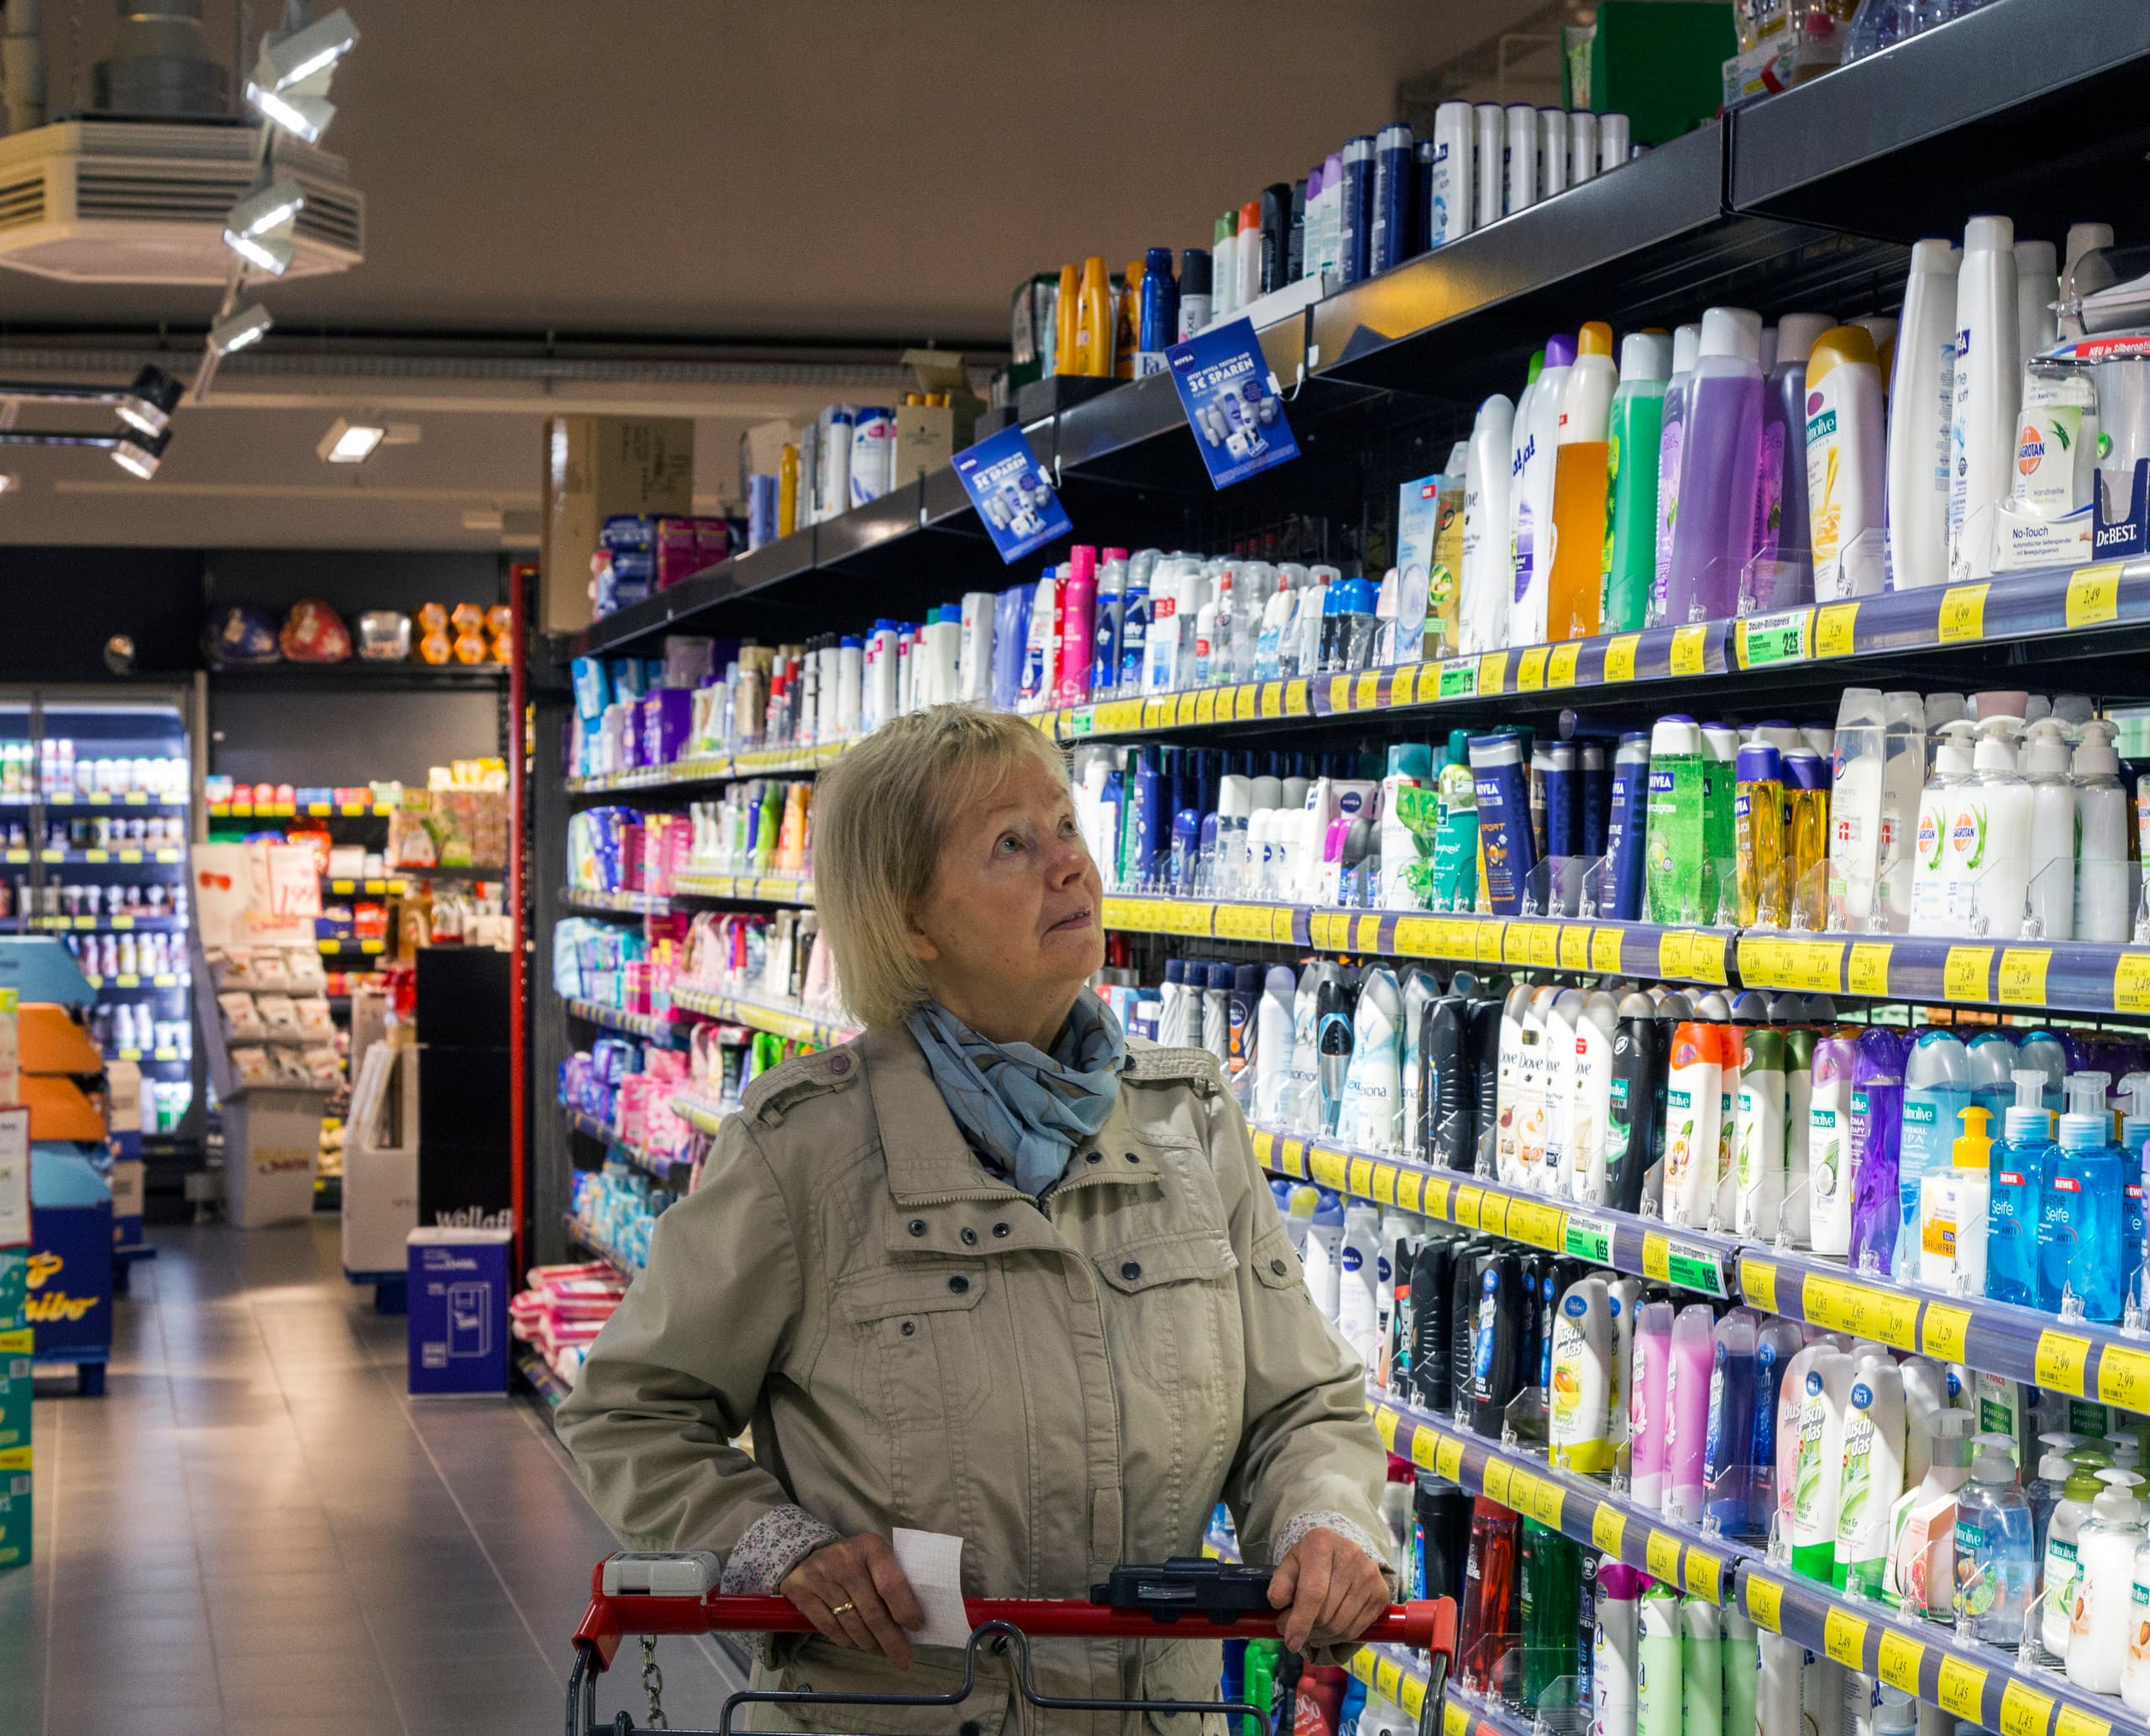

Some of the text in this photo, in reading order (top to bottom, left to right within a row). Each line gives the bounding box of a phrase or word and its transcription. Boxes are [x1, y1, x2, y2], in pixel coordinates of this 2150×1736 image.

[2089, 347, 2104, 356] NEU
[1173, 354, 1194, 366] NIVEA
[1188, 358, 1255, 392] 3€ SPAREN
[989, 456, 1027, 482] SPAREN
[2012, 526, 2048, 539] No-Touch
[1476, 781, 1499, 795] NIVEA
[1953, 827, 1974, 838] SAGROTAN
[2015, 970, 2031, 985] 3,49
[1518, 1052, 1544, 1071] Dove
[1545, 1059, 1560, 1073] ove
[2001, 1174, 2017, 1183] REWE
[2055, 1179, 2074, 1189] REWE
[1991, 1199, 2014, 1216] Seife
[2045, 1205, 2069, 1223] Seife
[1815, 1296, 1828, 1310] 1,65
[1851, 1304, 1864, 1319] 1,65
[1889, 1316, 1903, 1330] 1,99
[1565, 1340, 1583, 1358] das
[2053, 1356, 2070, 1371] 2,99
[2116, 1372, 2135, 1389] 2,99
[1854, 1392, 1868, 1404] Nr.1
[1784, 1400, 1801, 1421] dus
[1807, 1423, 1822, 1443] das
[1853, 1436, 1871, 1458] das
[1580, 1618, 1594, 1628] MEN
[1892, 1658, 1906, 1673] 1,45
[1953, 1684, 1969, 1701] 1,45
[2017, 1711, 2033, 1728] 1,45
